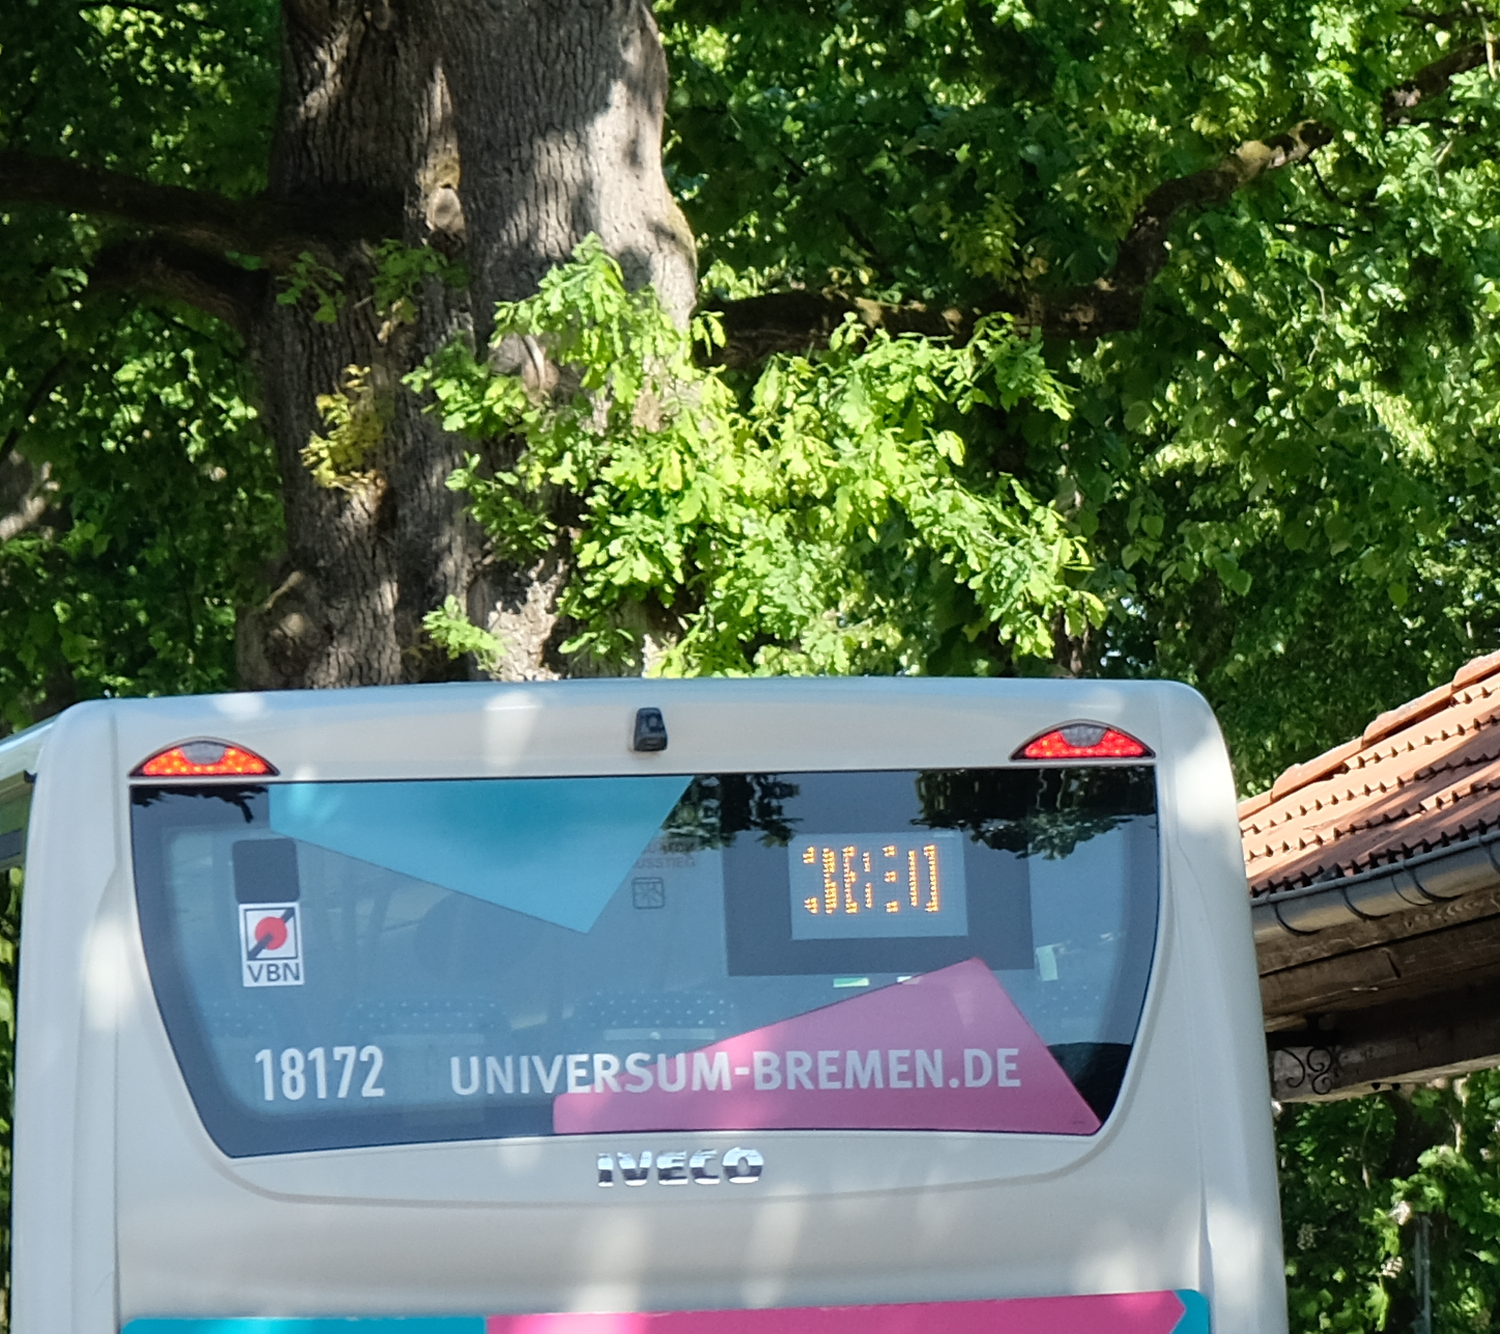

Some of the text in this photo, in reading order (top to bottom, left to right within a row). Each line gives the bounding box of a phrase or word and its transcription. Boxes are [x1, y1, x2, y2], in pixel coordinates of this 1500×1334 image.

[247, 963, 300, 983] VBN
[255, 1045, 386, 1101] 18172
[450, 1048, 1022, 1095] UNIVERSUM-BREMEN.DE
[597, 1146, 764, 1187] IVECO
